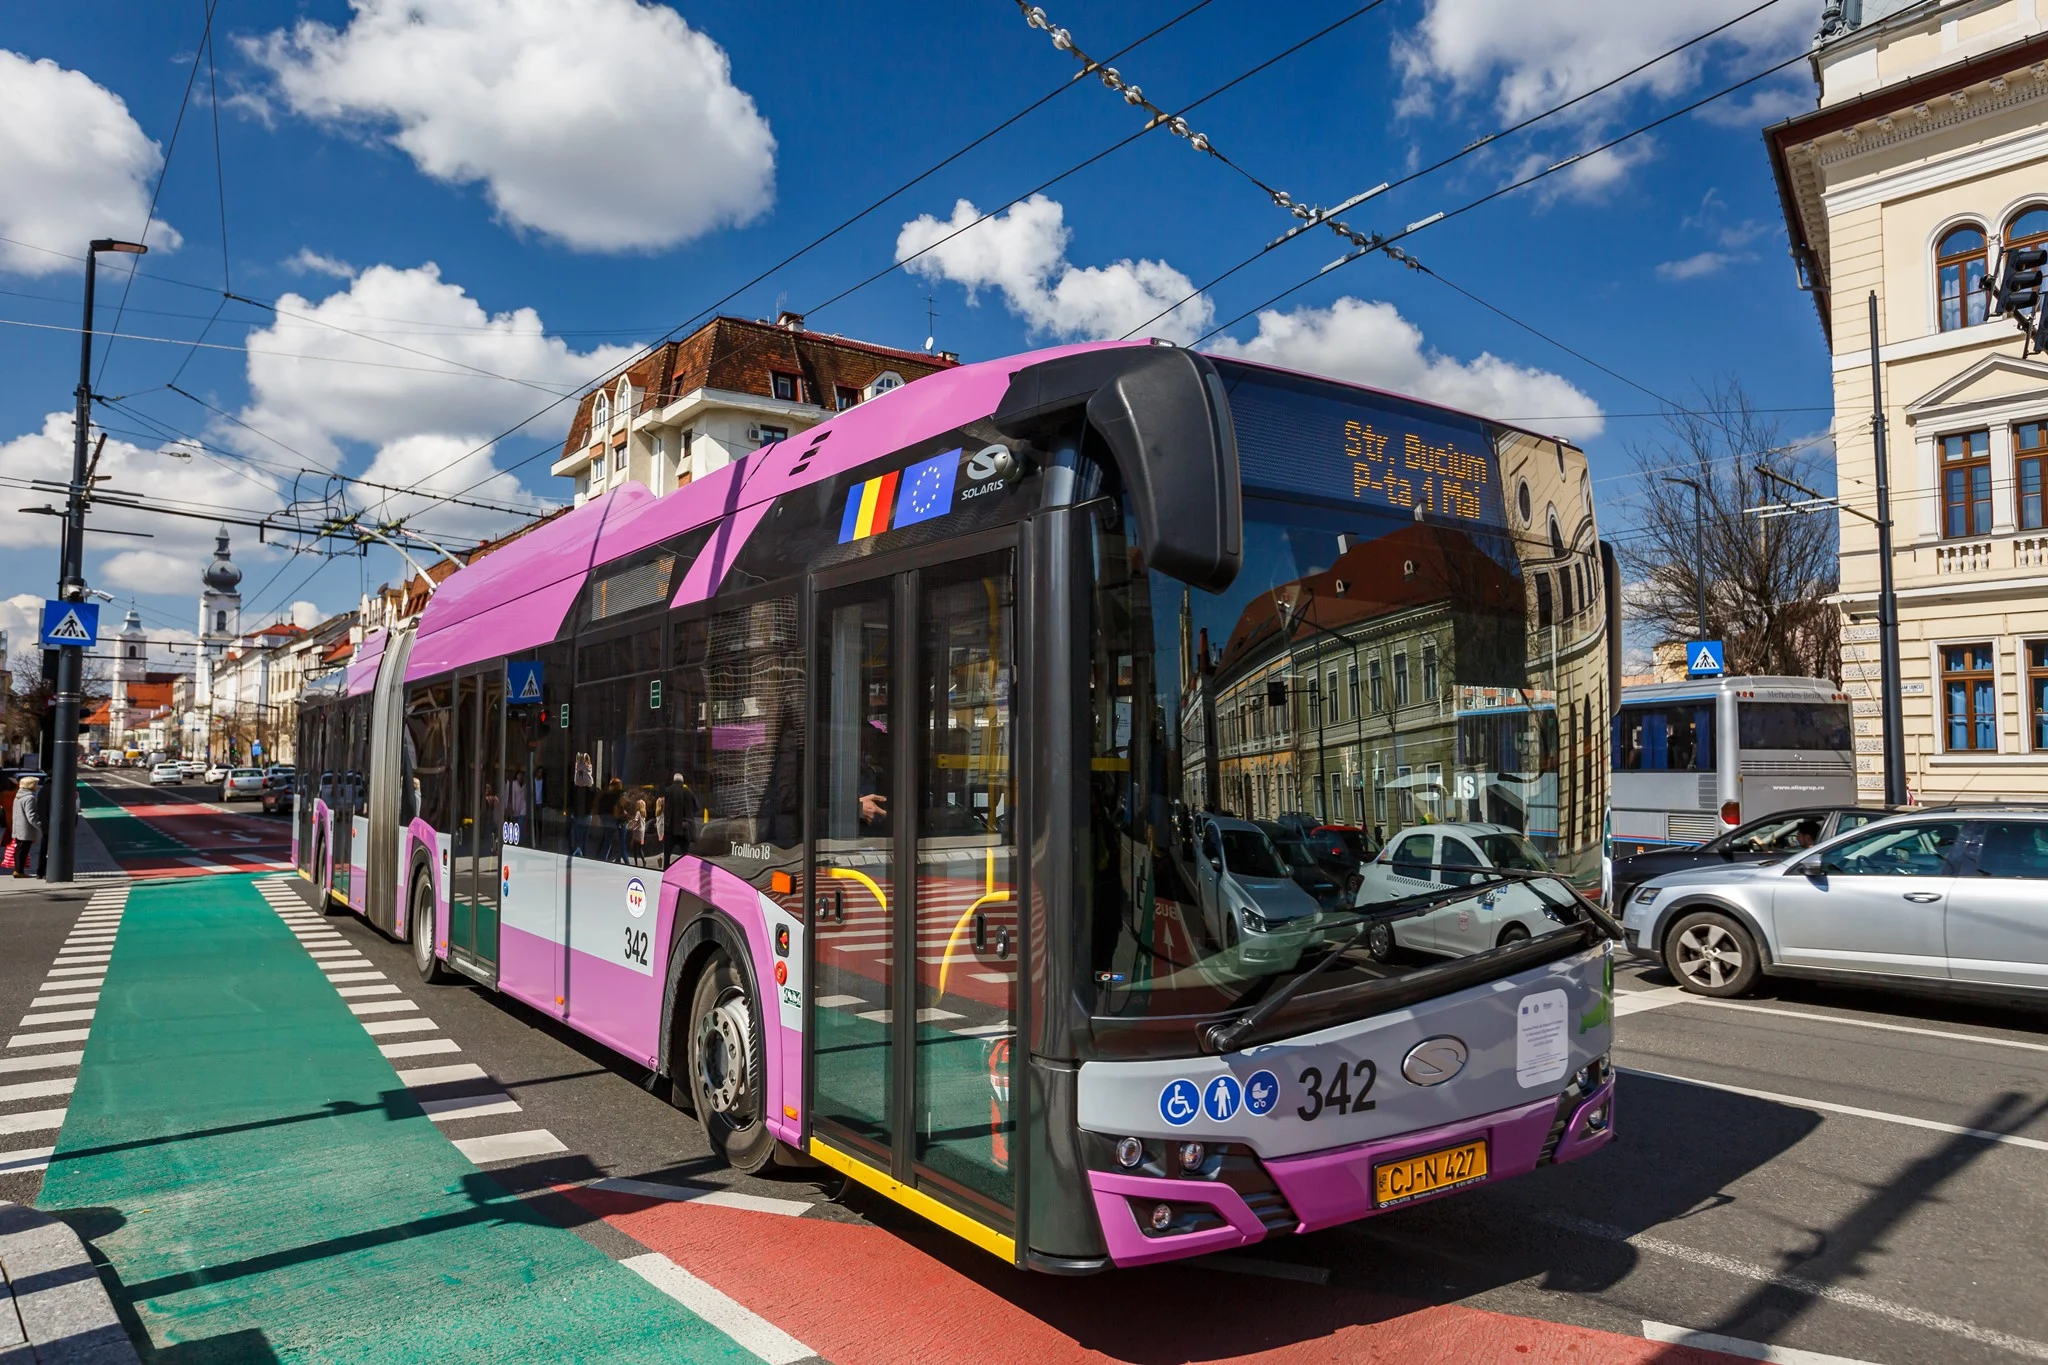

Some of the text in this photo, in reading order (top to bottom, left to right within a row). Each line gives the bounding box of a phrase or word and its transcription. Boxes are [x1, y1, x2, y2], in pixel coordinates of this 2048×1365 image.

[1345, 420, 1487, 484] Str. Bucium
[961, 479, 1004, 500] SOLARIS
[1354, 462, 1480, 519] P-ta 1 Mai
[731, 841, 770, 860] Trollino 18
[624, 926, 648, 966] 342
[1297, 1059, 1377, 1122] 342
[1390, 1157, 1438, 1195] CJ-N
[1445, 1147, 1476, 1180] 427
